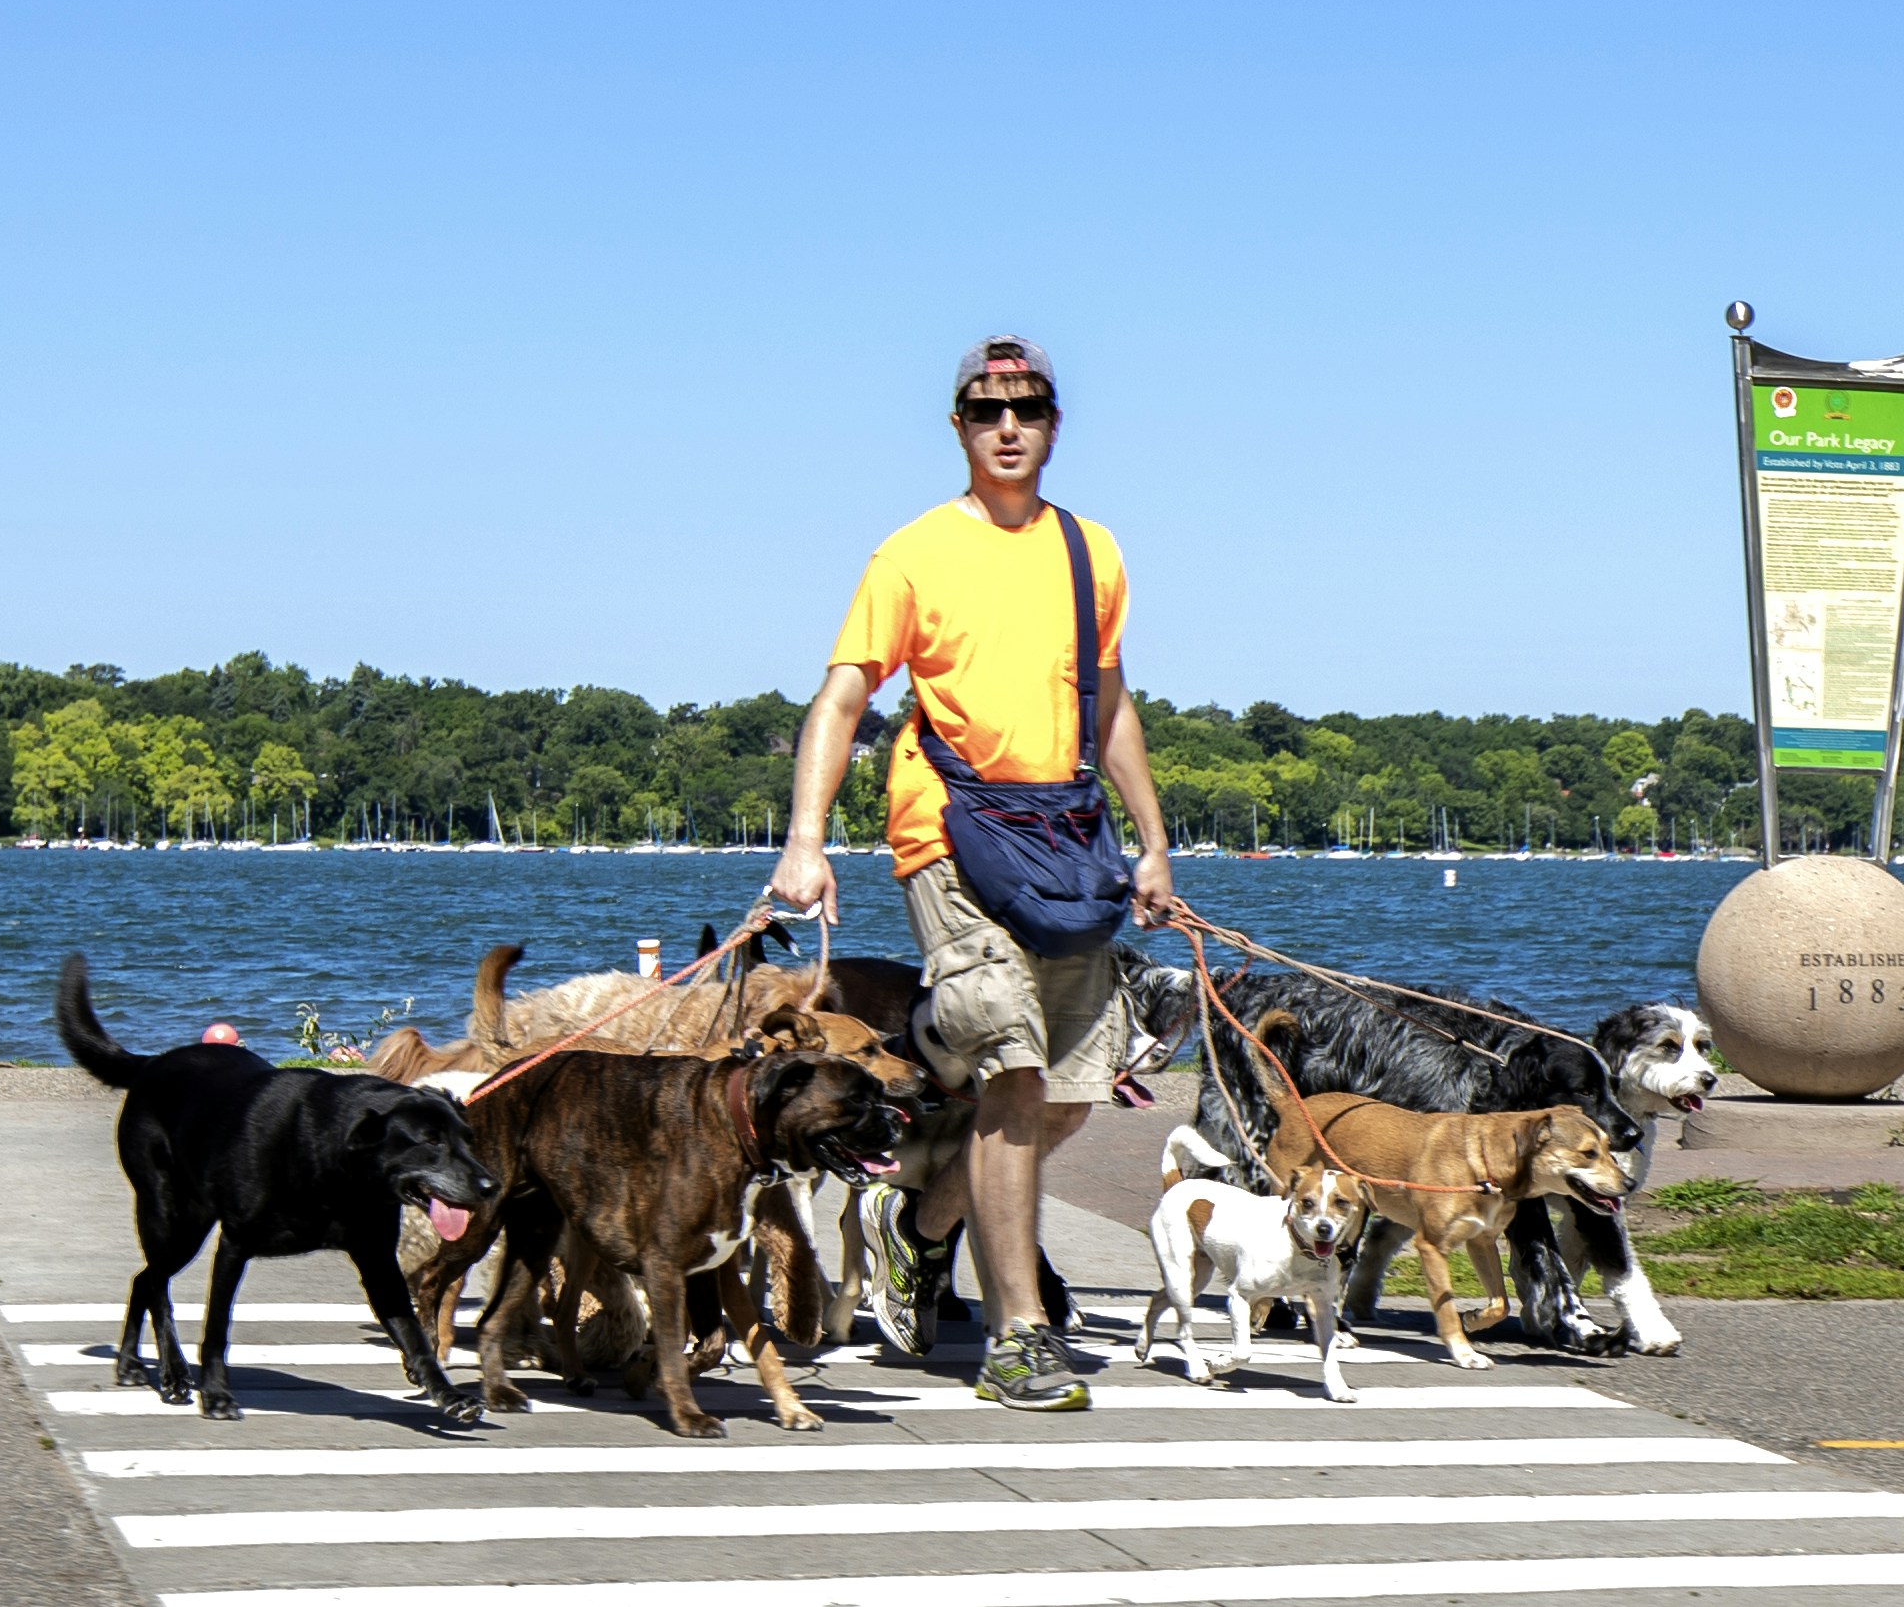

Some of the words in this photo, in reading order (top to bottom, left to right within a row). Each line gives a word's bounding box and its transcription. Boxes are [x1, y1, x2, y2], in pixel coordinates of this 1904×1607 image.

[1769, 429, 1803, 446] Our
[1806, 431, 1841, 448] Park
[1844, 433, 1895, 454] Legacy
[1762, 456, 1811, 468] Established
[1812, 458, 1823, 471] by
[1845, 459, 1867, 472] April
